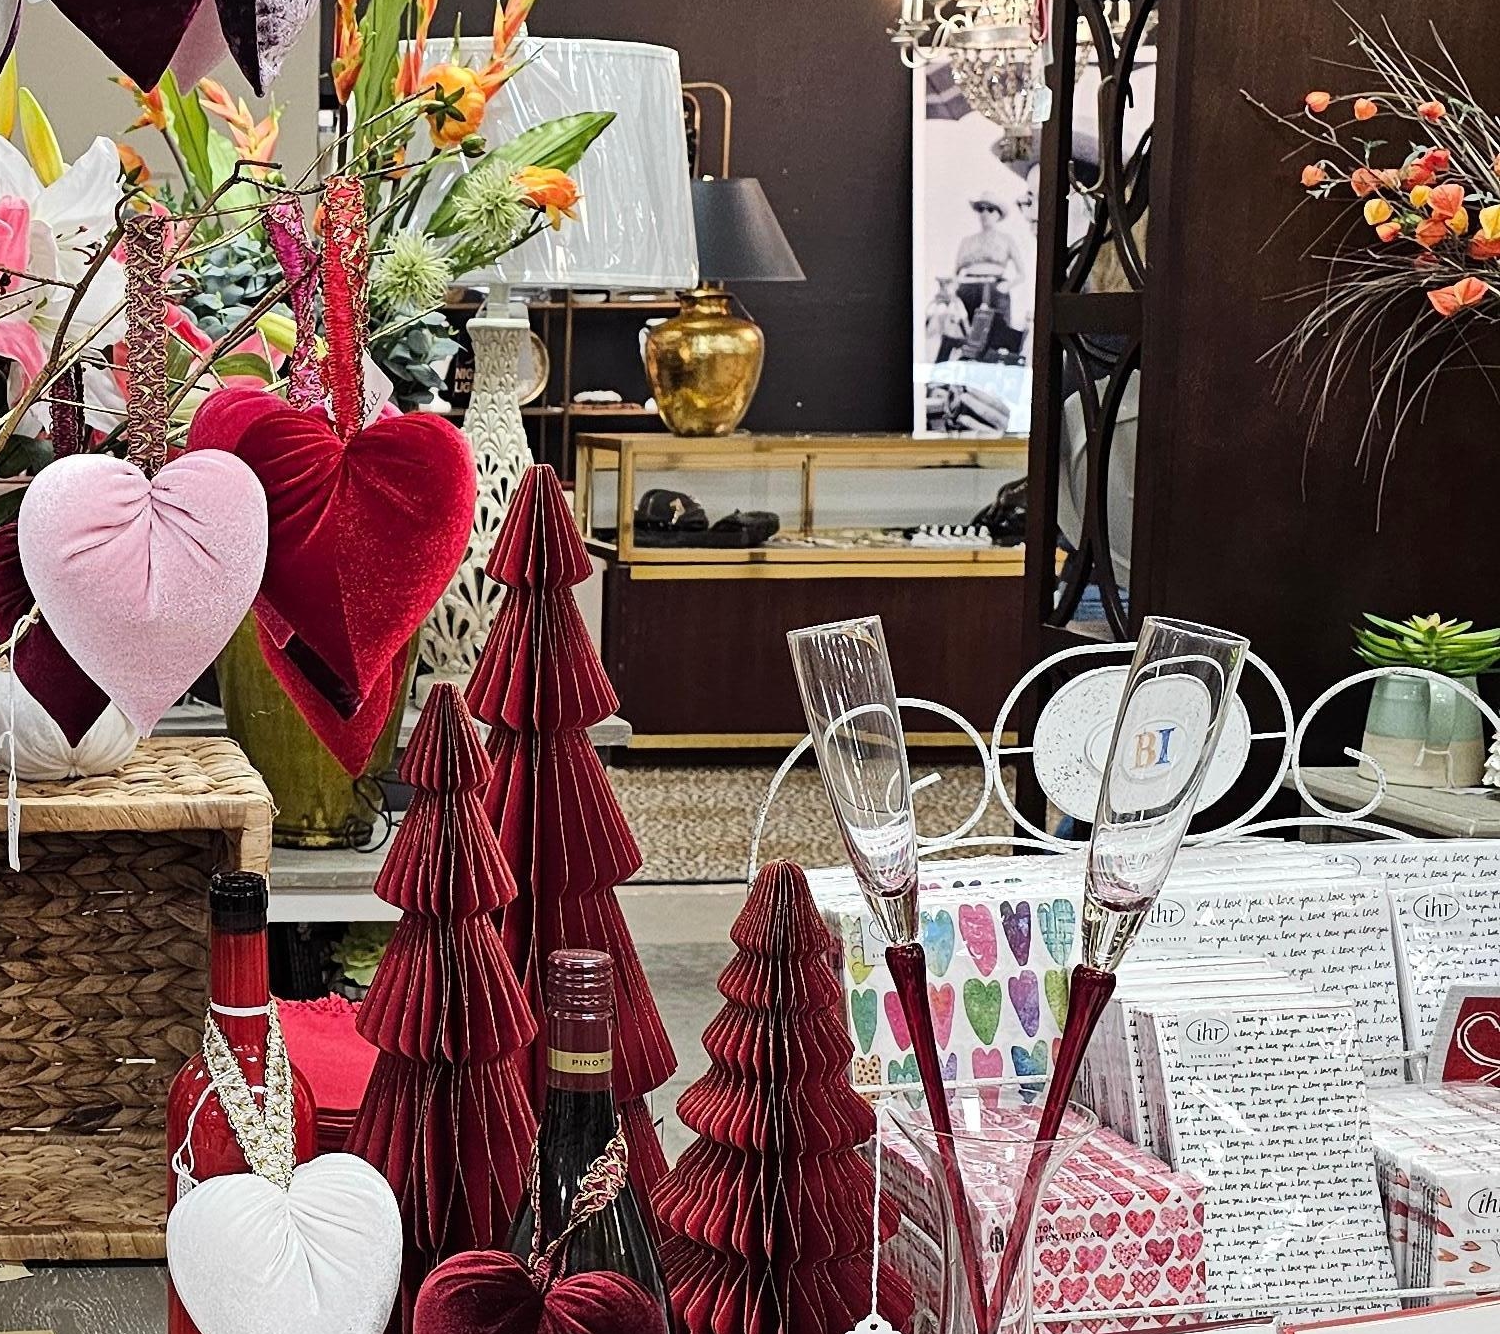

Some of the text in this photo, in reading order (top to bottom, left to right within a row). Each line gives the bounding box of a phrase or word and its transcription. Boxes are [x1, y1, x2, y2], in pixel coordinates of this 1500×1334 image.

[455, 368, 474, 380] NIG
[454, 381, 474, 393] LIG
[1425, 897, 1453, 917] ihr
[1197, 1022, 1223, 1041] ihr
[572, 1058, 605, 1067] PINOT
[1035, 1230, 1102, 1244] TERNATIONAL
